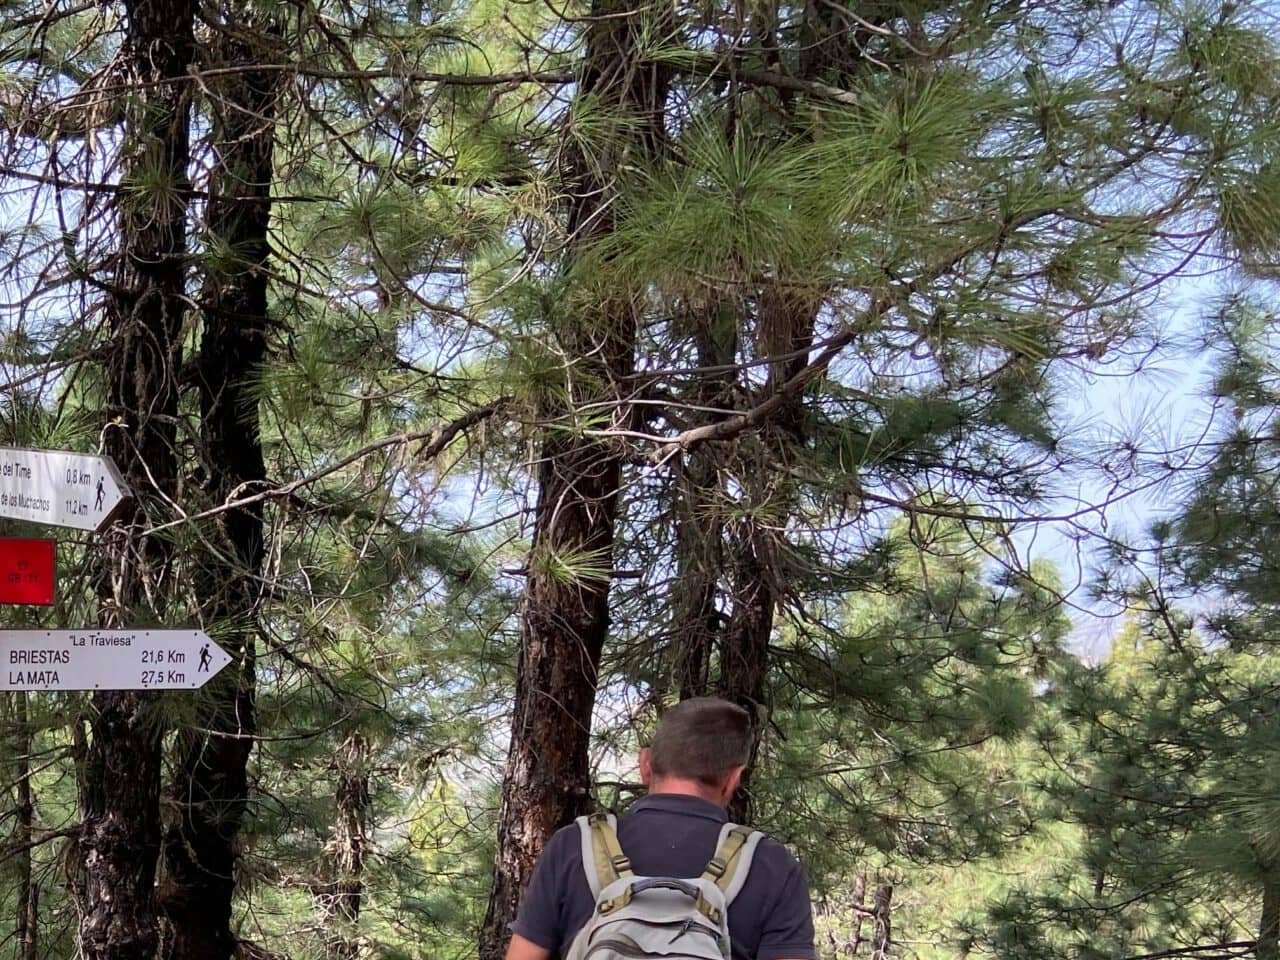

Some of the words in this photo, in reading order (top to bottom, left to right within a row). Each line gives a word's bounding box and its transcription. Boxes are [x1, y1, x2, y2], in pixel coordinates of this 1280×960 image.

[2, 462, 13, 477] del
[15, 463, 31, 480] Time
[66, 469, 78, 486] 0,8
[79, 470, 91, 486] km
[1, 493, 8, 506] de
[9, 493, 17, 507] los
[18, 494, 50, 511] Muchachos
[65, 501, 77, 516] 11,2
[78, 504, 88, 516] km
[69, 635, 86, 647] "La
[89, 635, 136, 647] Traviesa"
[9, 650, 70, 664] BRIESTAS
[141, 650, 164, 664] 21,6
[167, 650, 185, 664] Km
[9, 671, 25, 684] LA
[27, 671, 60, 684] MATA
[141, 671, 164, 684] 27,5
[167, 671, 185, 683] Km
